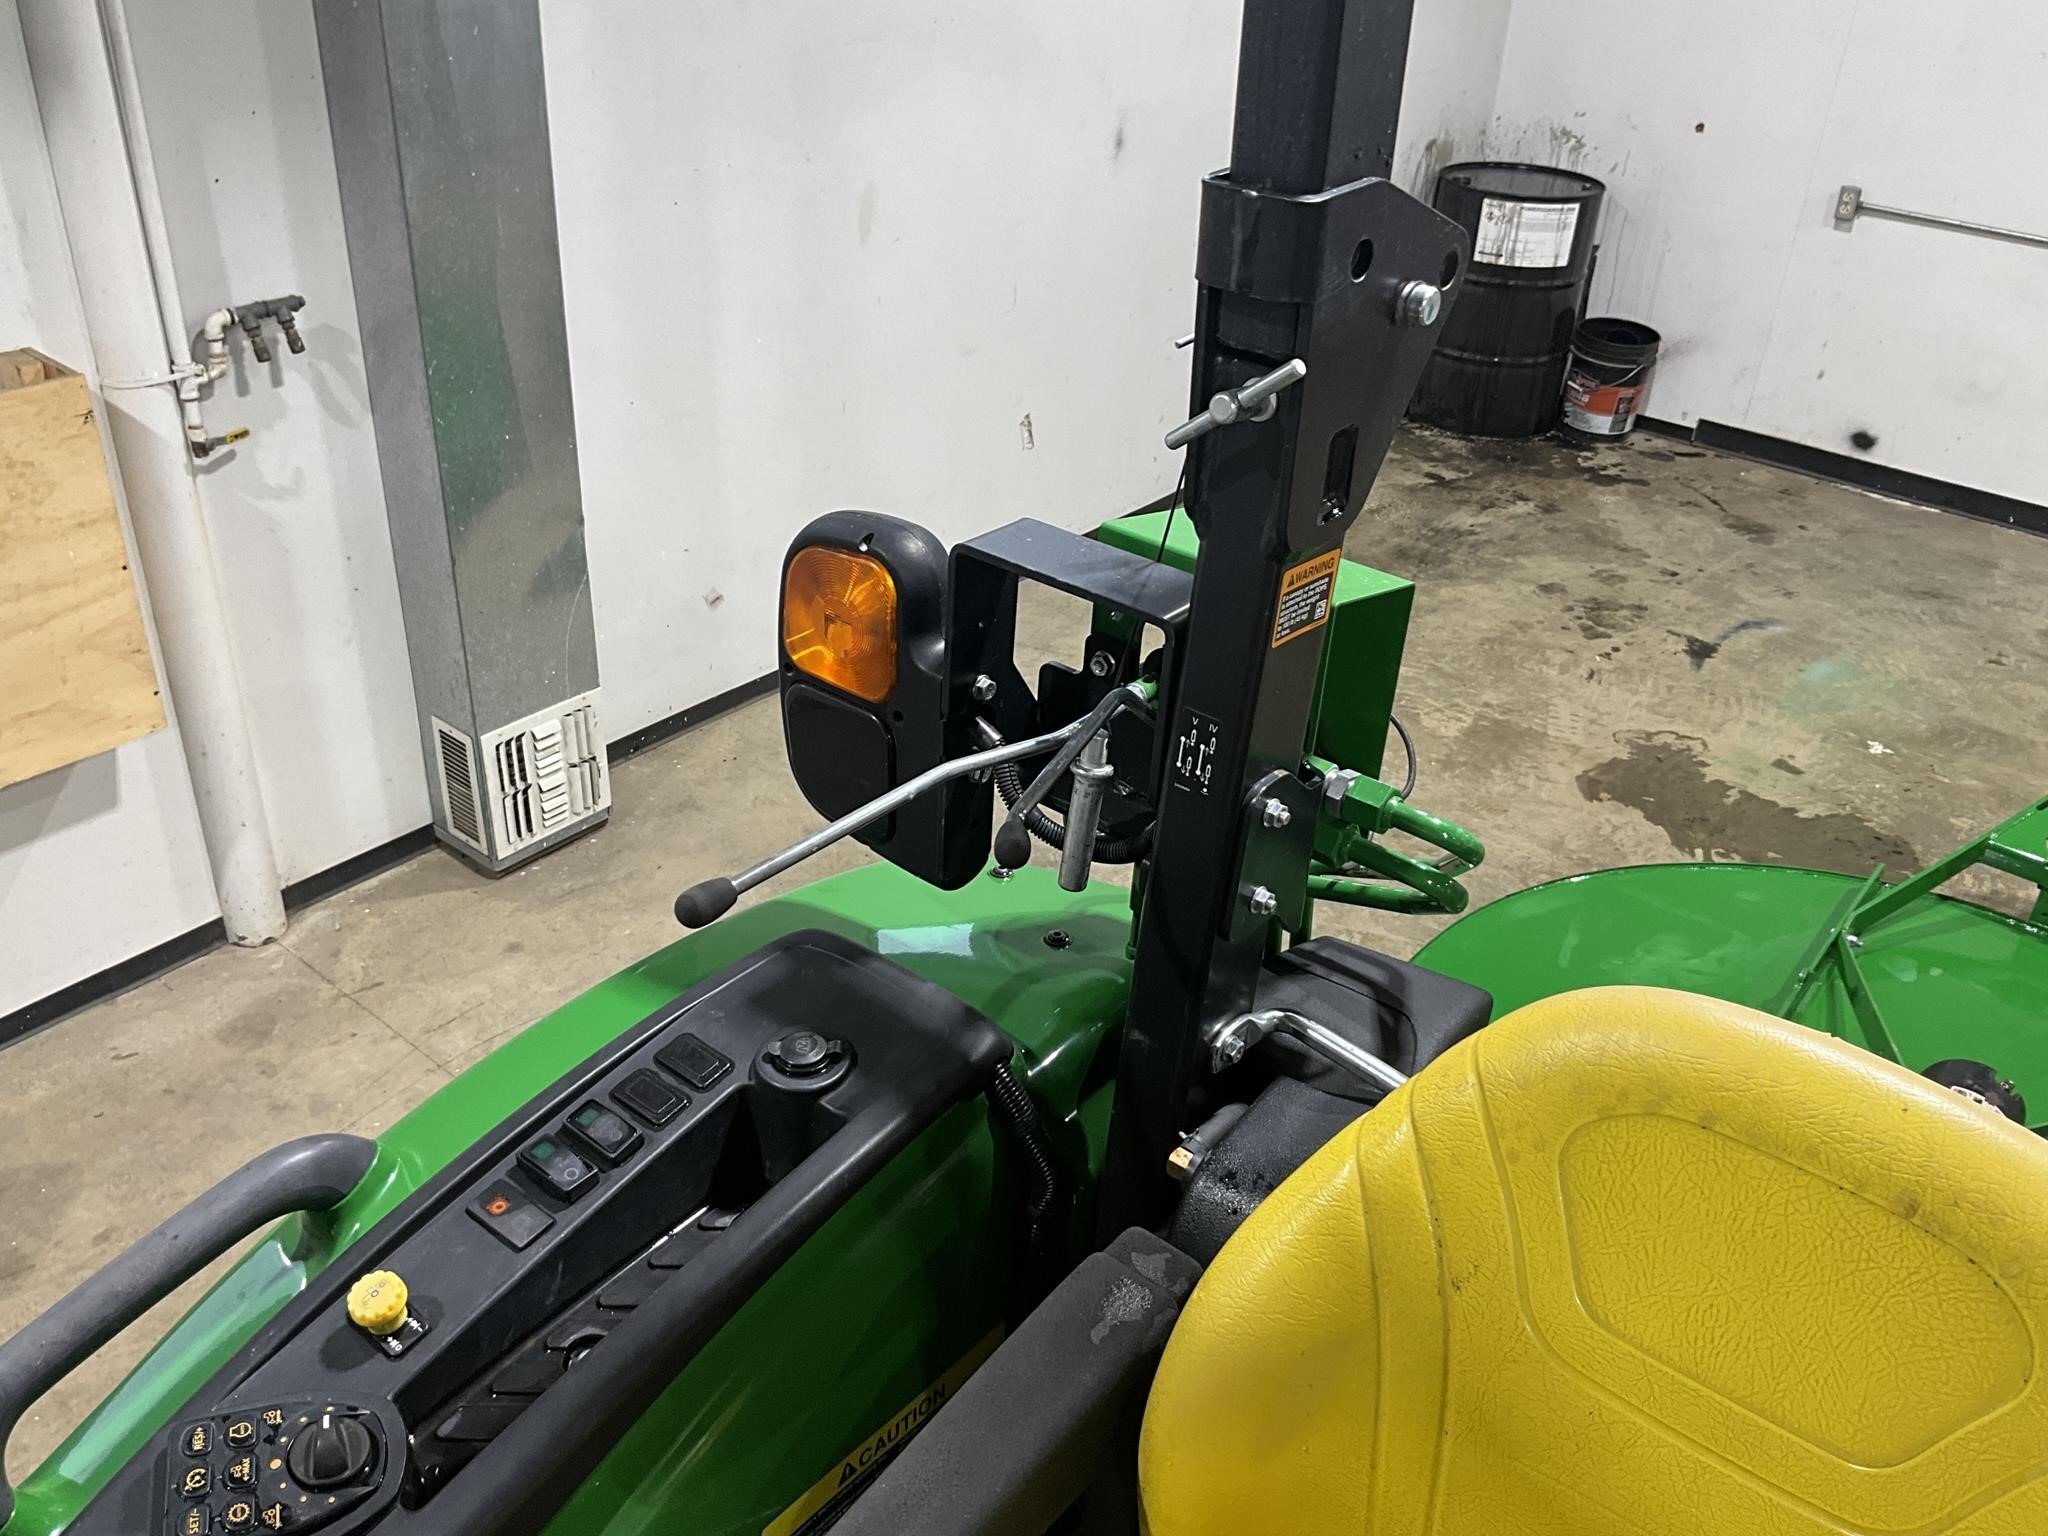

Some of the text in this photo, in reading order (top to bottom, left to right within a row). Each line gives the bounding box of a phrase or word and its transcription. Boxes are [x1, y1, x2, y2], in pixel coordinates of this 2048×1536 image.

[1295, 557, 1334, 583] WARNING
[1192, 716, 1199, 725] V
[1208, 723, 1218, 733] IV
[858, 1382, 946, 1466] CAUTION
[241, 1457, 250, 1474] MAX
